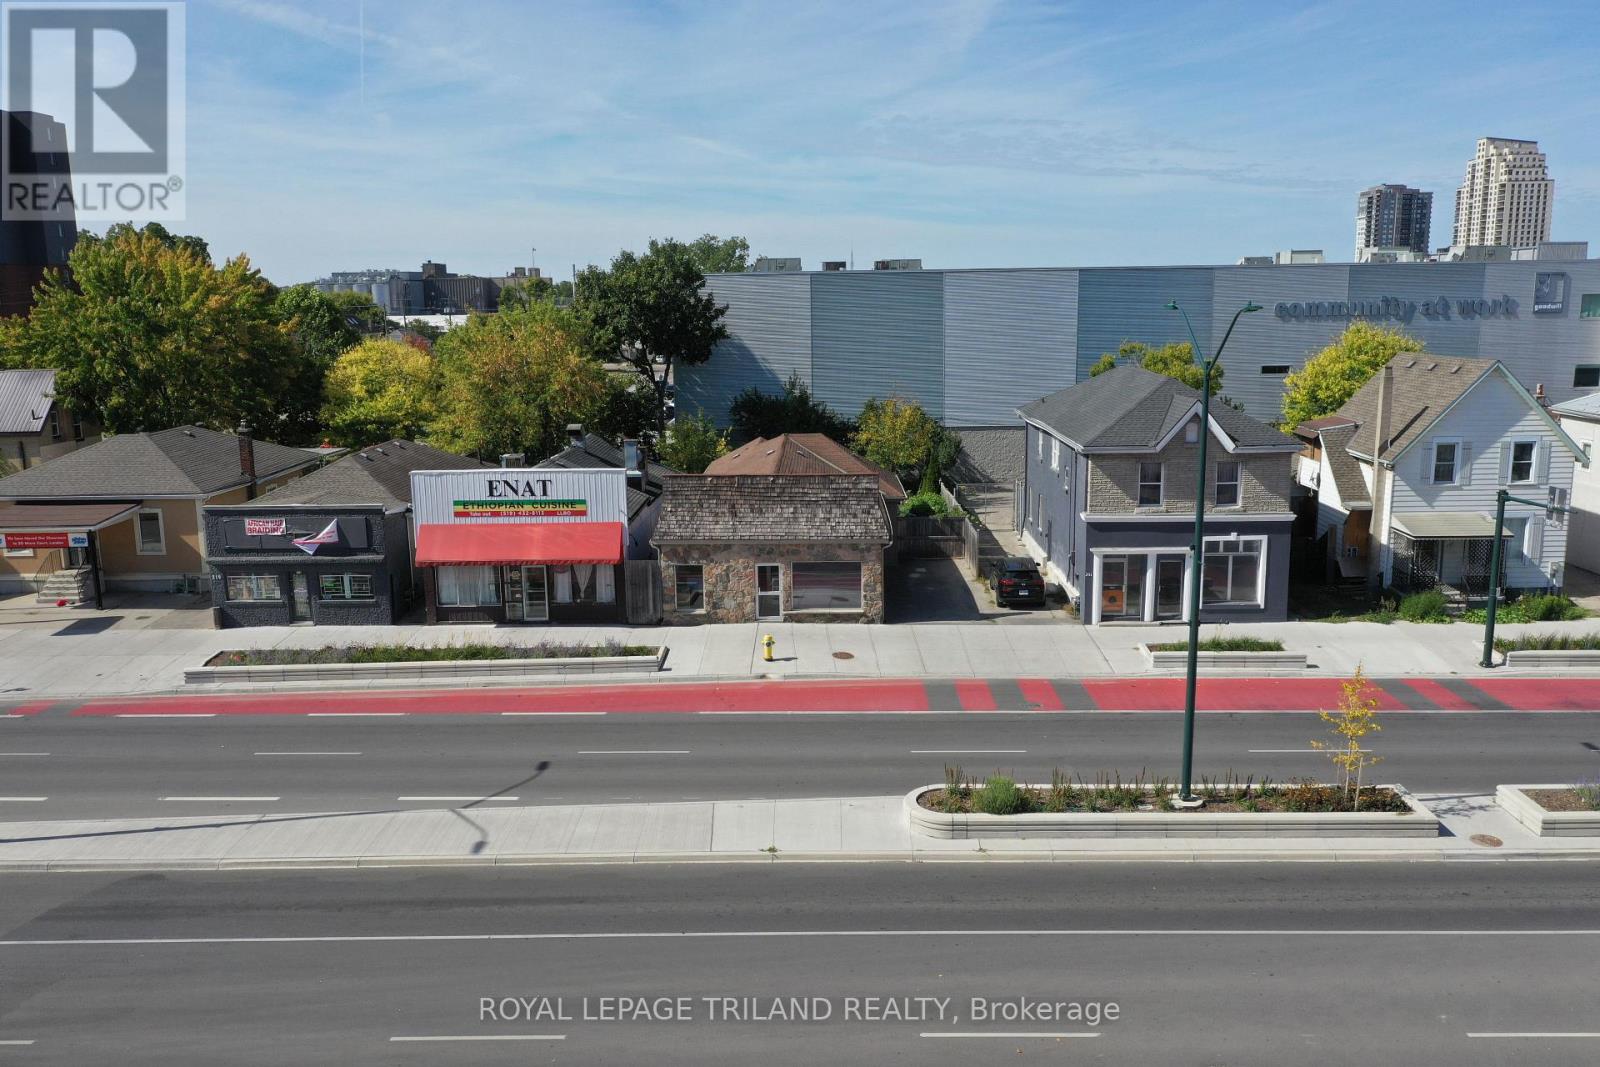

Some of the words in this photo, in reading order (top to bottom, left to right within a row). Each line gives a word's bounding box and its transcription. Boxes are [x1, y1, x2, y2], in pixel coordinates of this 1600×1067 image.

[1274, 296, 1412, 321] community
[1420, 296, 1447, 316] at
[1456, 295, 1514, 316] work
[1534, 303, 1562, 311] goodwill
[487, 479, 552, 497] ENAT
[531, 501, 577, 509] CUISINE
